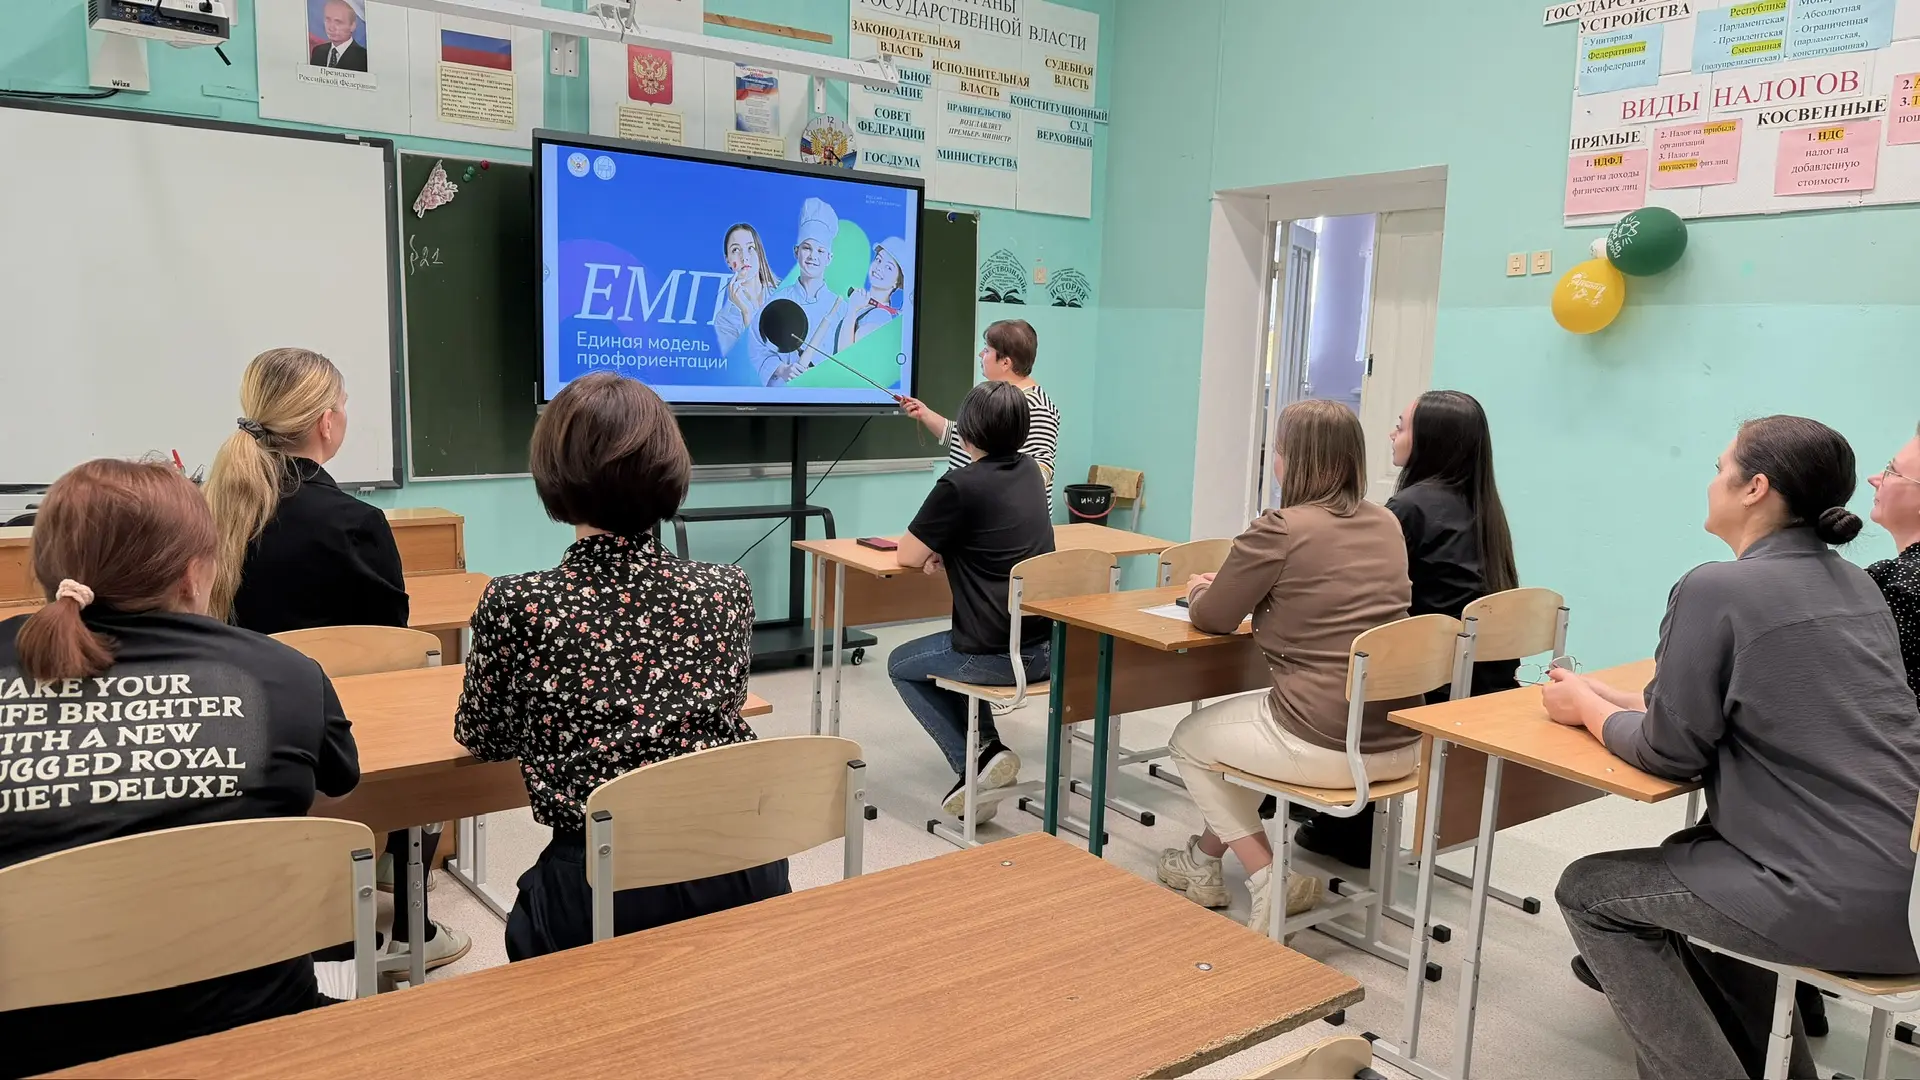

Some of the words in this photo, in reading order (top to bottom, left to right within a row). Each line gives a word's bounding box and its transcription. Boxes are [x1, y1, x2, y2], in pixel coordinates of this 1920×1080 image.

[1580, 3, 1690, 33] УСТРОЙСТВА
[1803, 4, 1861, 20] Абсолютная
[860, 0, 1022, 37] СУДАРСТВЕННОЙ
[1029, 25, 1087, 51] ВЛАСТИ
[1719, 16, 1785, 32] Парламентская
[1801, 17, 1868, 33] Ограниченная
[851, 20, 960, 49] ЗАКОНОДАТЕЛЬНАЯ
[1590, 34, 1633, 46] Унитарная
[1719, 29, 1783, 45] Президентская
[880, 41, 923, 58] ВЛАСТЬ
[932, 60, 1030, 87] ИСПОЛНИТЕЛЬНАЯ
[1045, 58, 1093, 76] СУДЕБНАЯ
[1586, 59, 1646, 74] Конфедерация
[960, 81, 999, 97] ВЛАСТЬ
[1054, 74, 1089, 90] ВЛАСТЬ
[1622, 91, 1700, 119] ВИДЫ
[1714, 70, 1859, 108] НАЛОГОВ
[874, 107, 911, 122] СОВЕТ
[947, 103, 1011, 120] ПРАВИТЕЛЬСТВО
[1010, 95, 1108, 121] КОНСТИТУЦИОННЫЙ
[1757, 99, 1887, 126] КОСВЕННЫЕ
[827, 115, 835, 124] 12
[1070, 120, 1088, 133] СУД
[857, 120, 925, 140] ФЕДЕРАЦИИ
[1037, 130, 1093, 147] ВЕРХОВНЫЙ
[1818, 129, 1844, 141] НДС
[1571, 130, 1641, 150] ПРЯМЫЕ
[865, 151, 920, 168] ГОС.ДУМА
[937, 149, 1018, 169] МИНИСТЕРСТВА
[1805, 148, 1834, 157] налог
[1594, 156, 1623, 167] НДФЛ
[1791, 160, 1860, 174] добавленную
[1797, 177, 1850, 187] стоимость
[574, 262, 735, 326] ЕМП
[1050, 282, 1086, 301] ИСТОРИЯ
[577, 331, 643, 350] Единая
[648, 337, 710, 352] модель
[577, 350, 728, 371] профориентации
[0, 676, 83, 699] AKE
[92, 674, 193, 698] YOUR
[57, 696, 245, 725] BRIGHTER
[0, 730, 72, 755] ITH
[78, 727, 108, 749] A
[116, 723, 201, 747] NEW
[130, 746, 246, 773] ROYAL
[89, 775, 244, 804] DELUXE.
